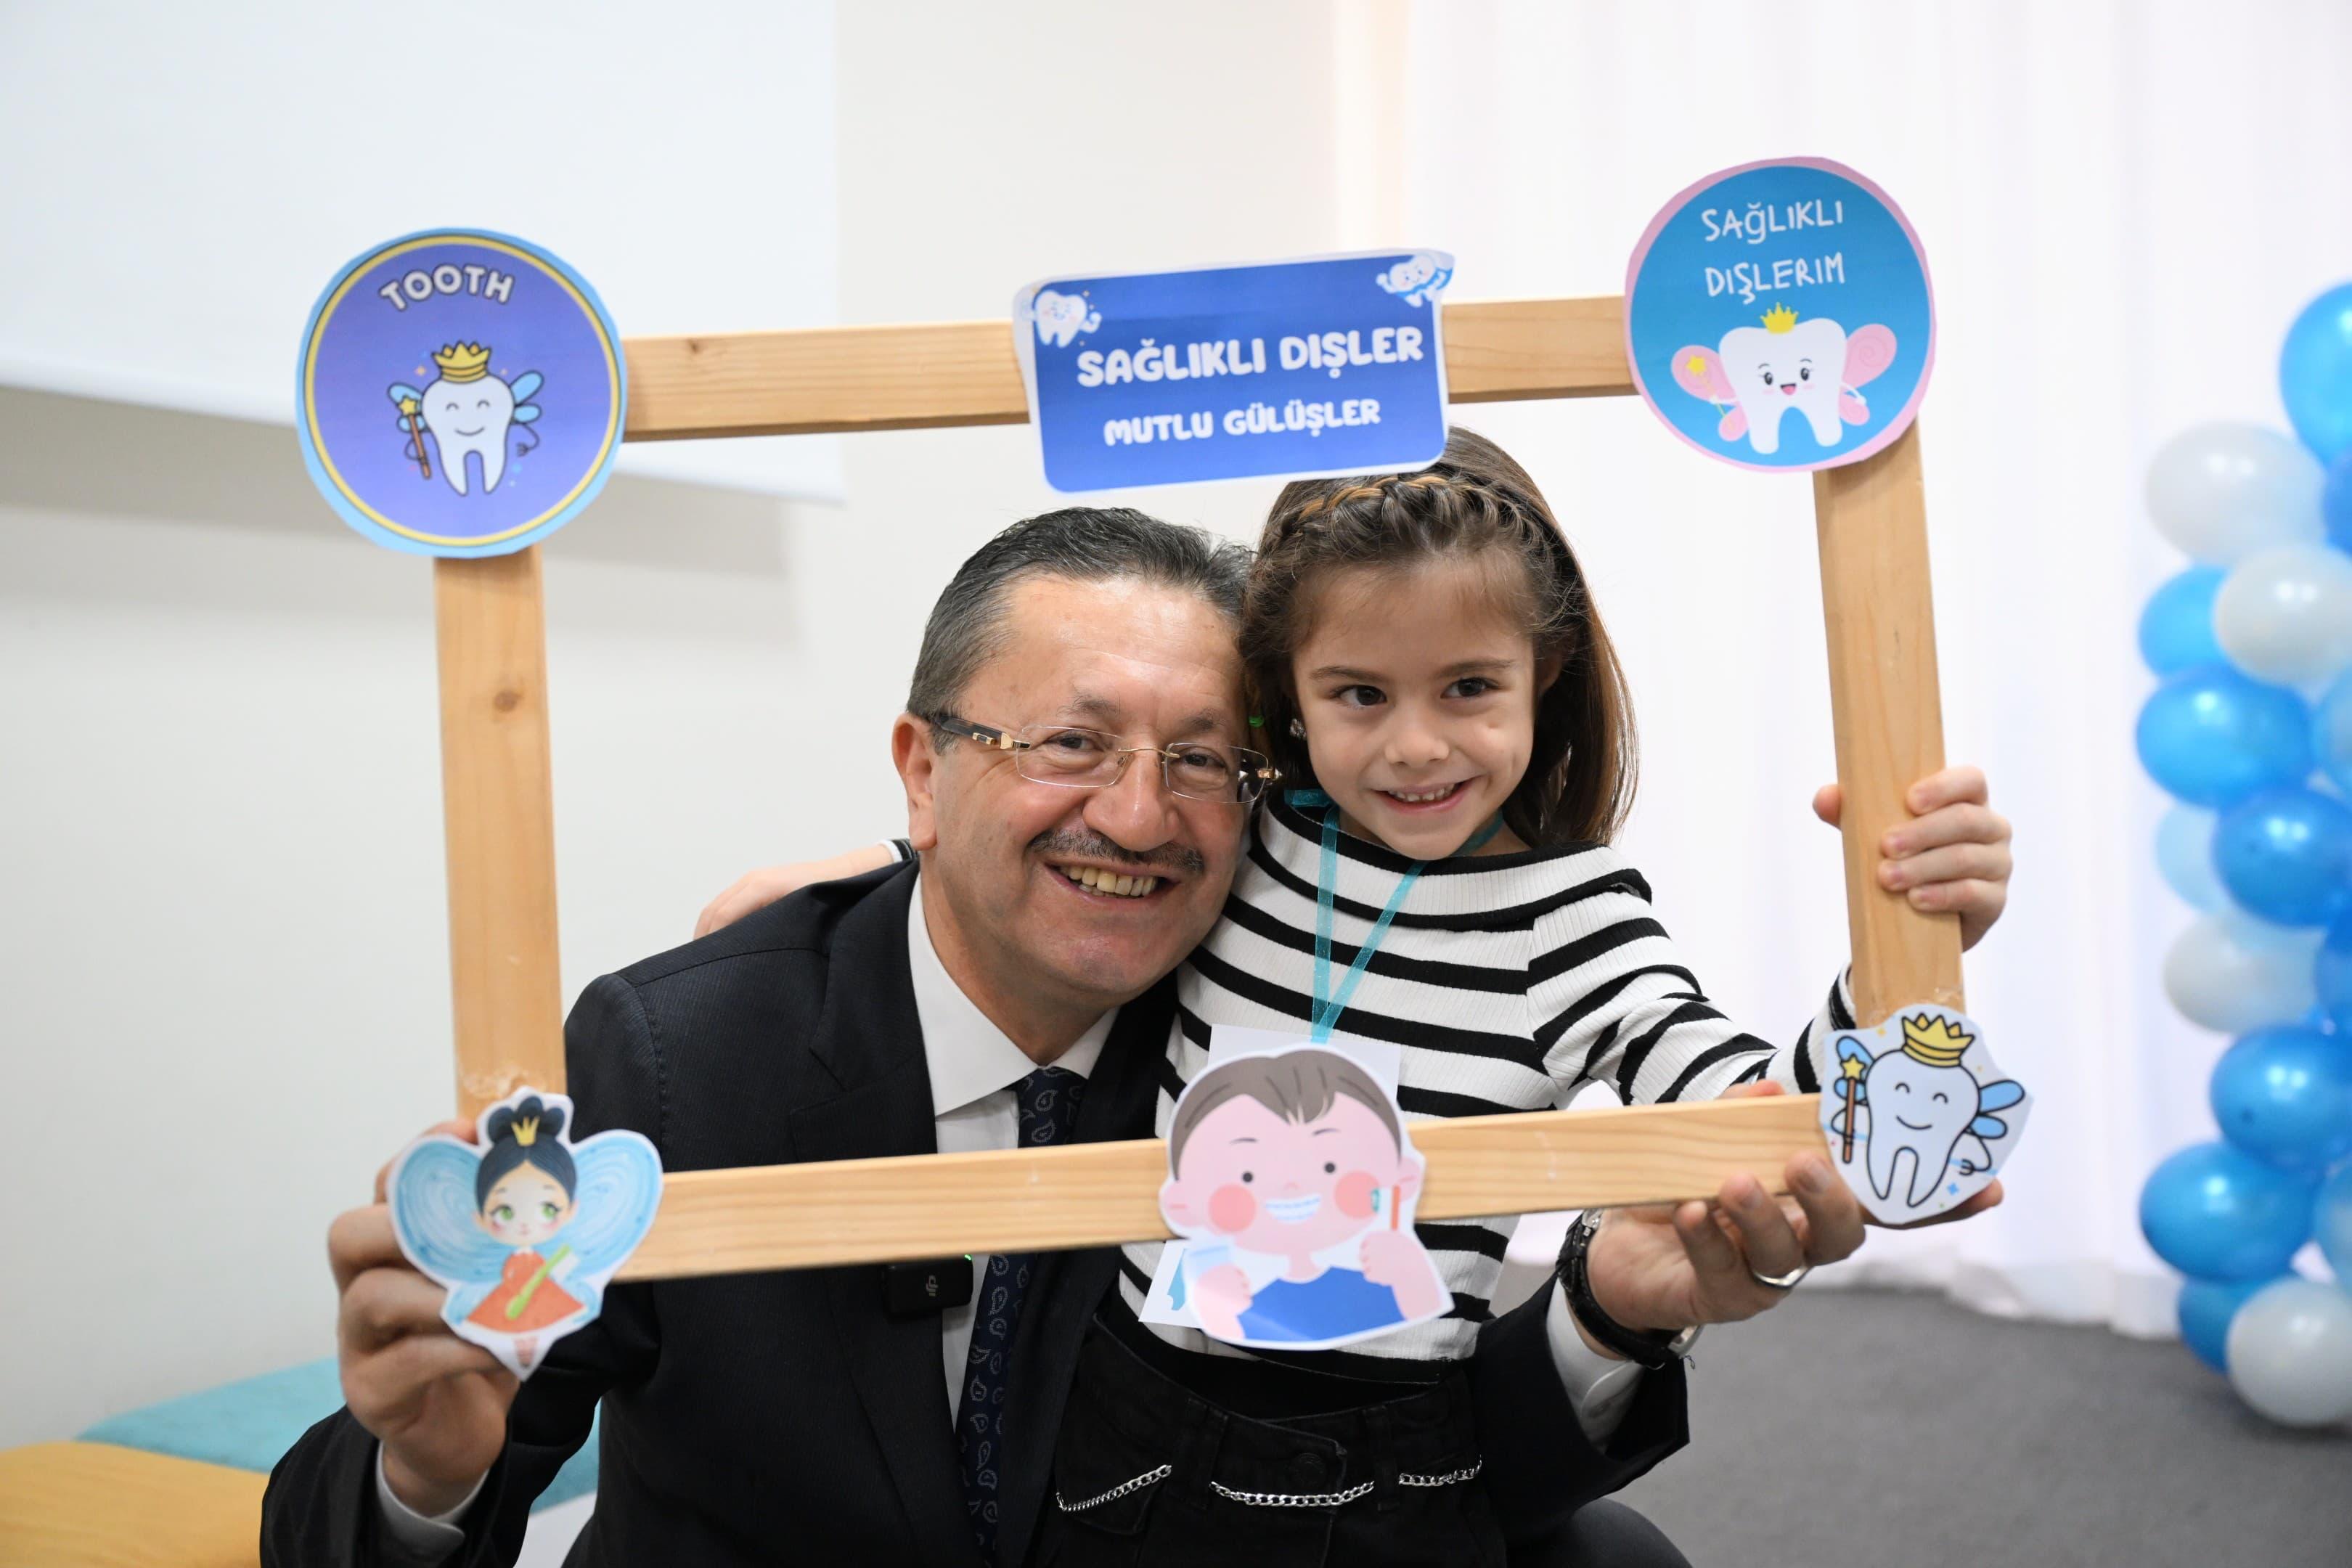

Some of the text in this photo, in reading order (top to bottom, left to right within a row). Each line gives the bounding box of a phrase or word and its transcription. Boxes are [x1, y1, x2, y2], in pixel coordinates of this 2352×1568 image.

[380, 264, 514, 311] TOOTH
[1704, 252, 1845, 304] DIŞLERIM
[1077, 327, 1424, 386] SAĞLIKLI DIŞLER
[1104, 399, 1381, 446] MUTLU GÜLÜŞLER
